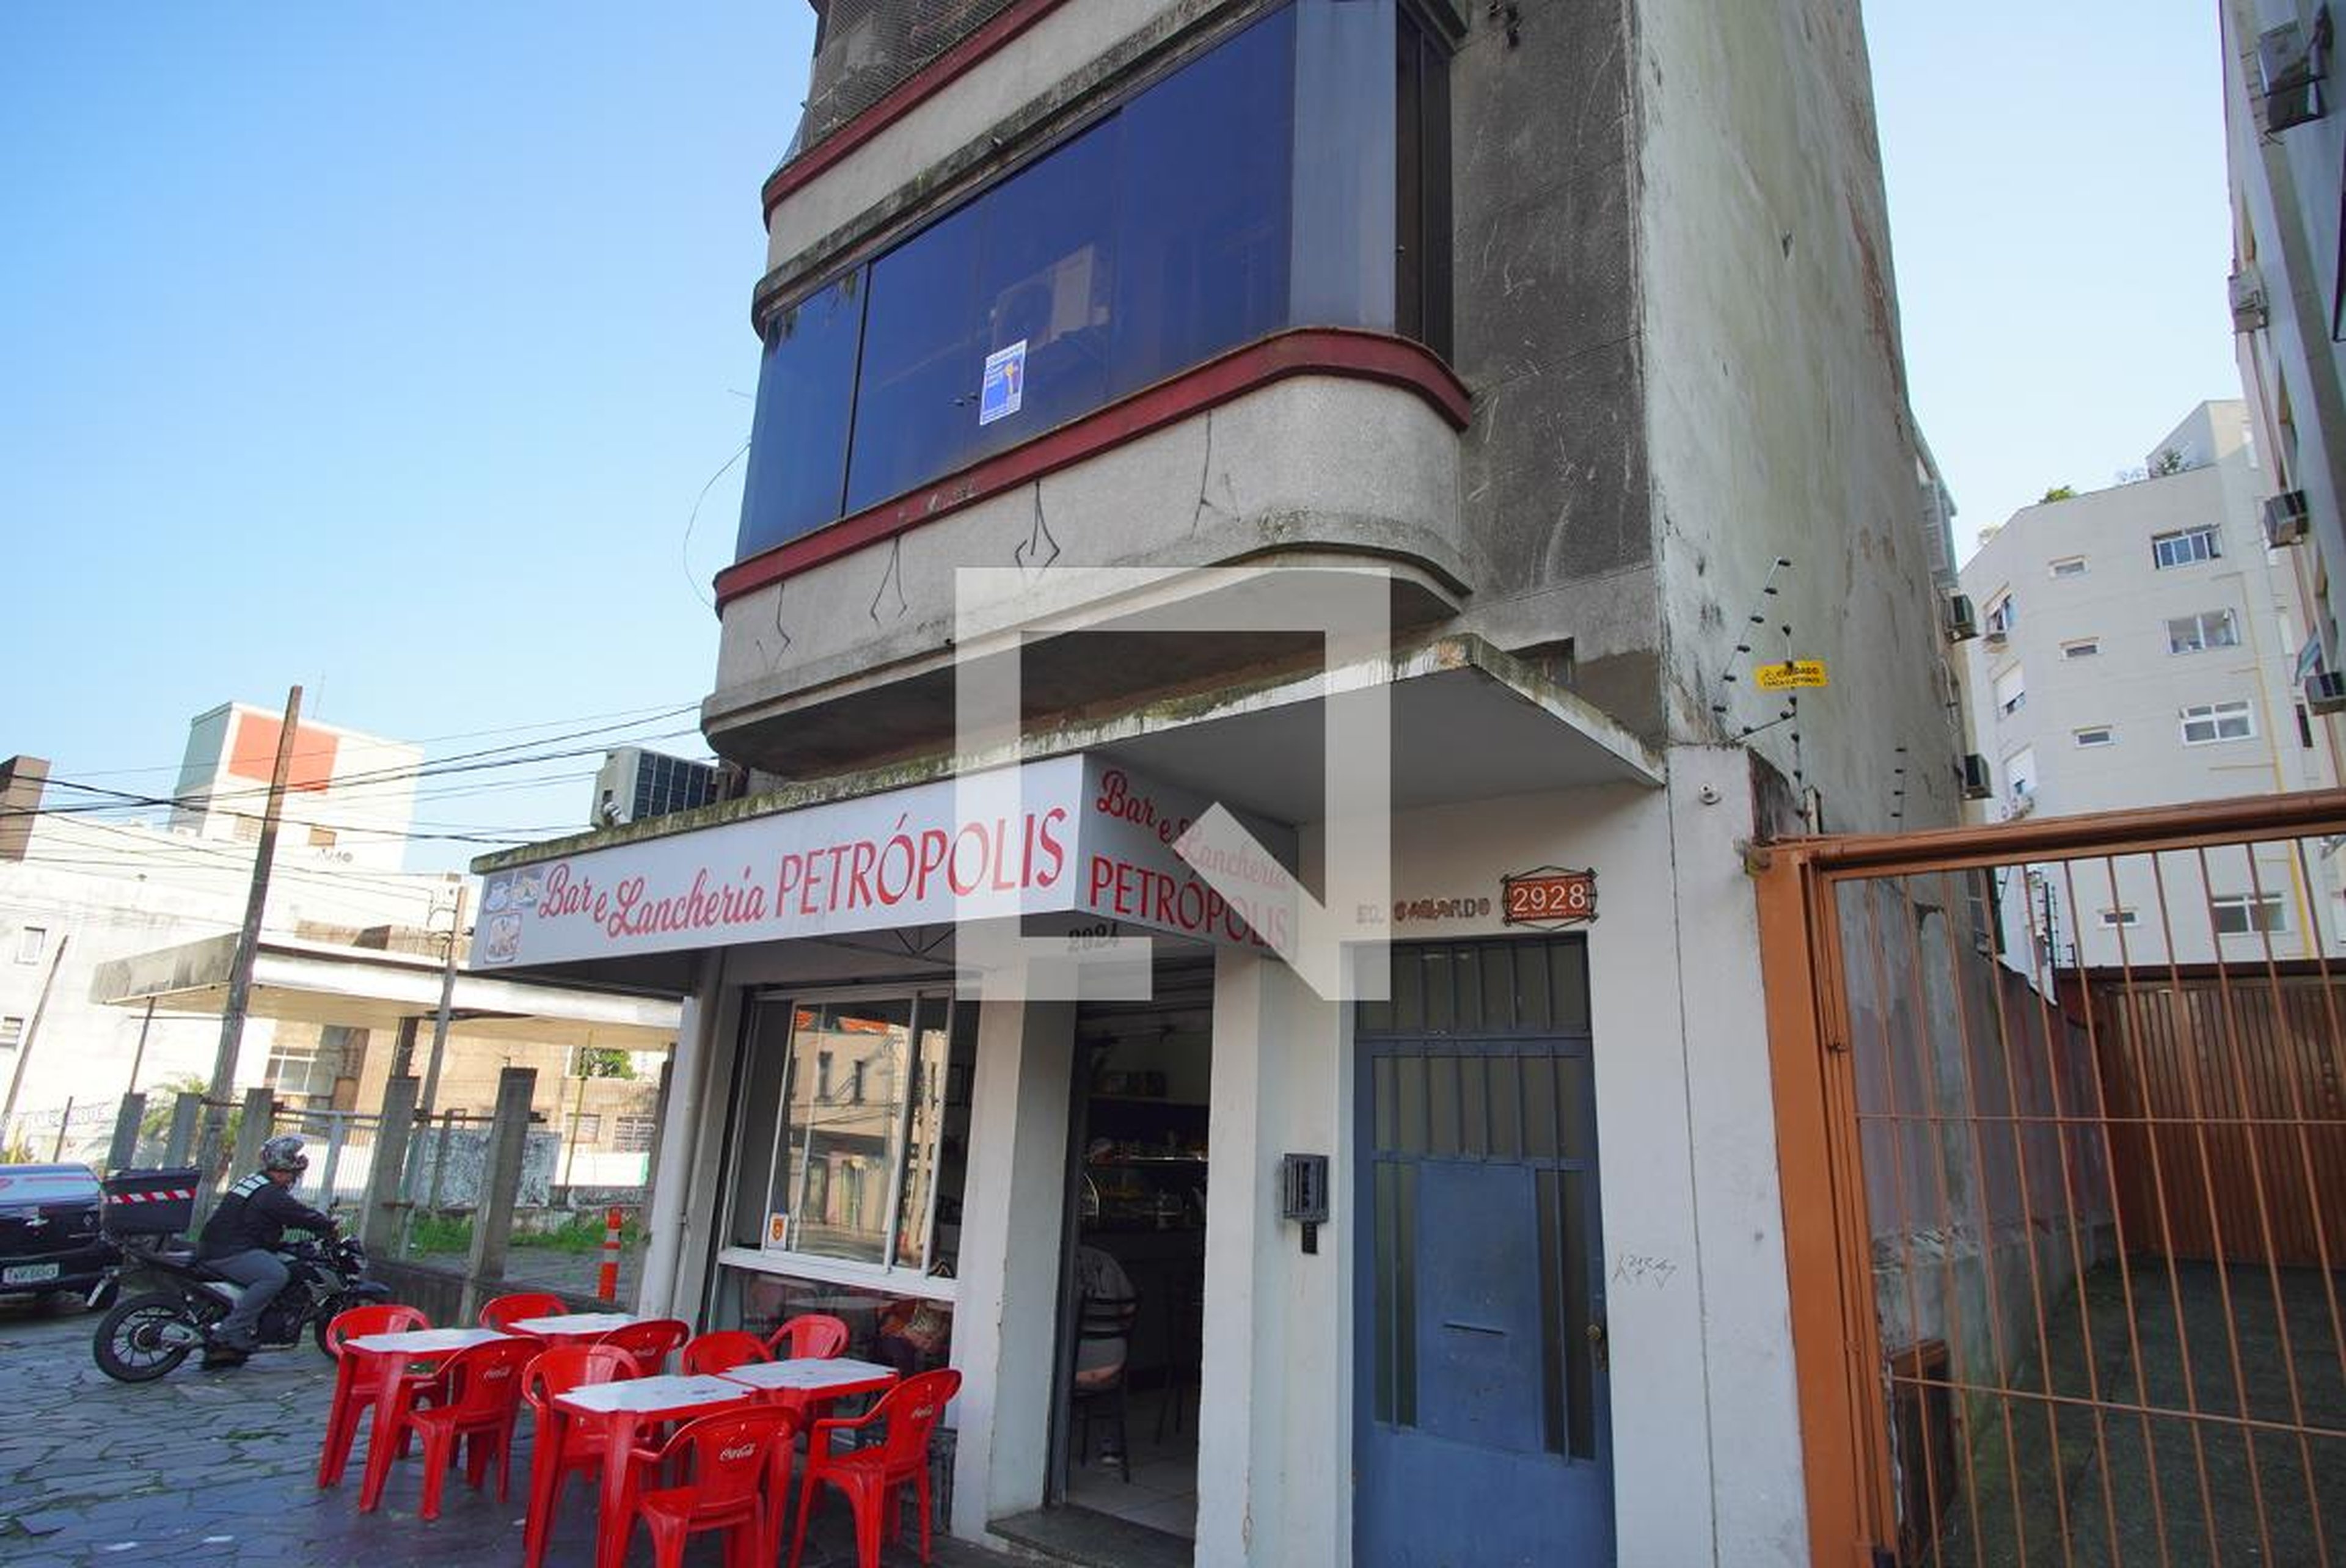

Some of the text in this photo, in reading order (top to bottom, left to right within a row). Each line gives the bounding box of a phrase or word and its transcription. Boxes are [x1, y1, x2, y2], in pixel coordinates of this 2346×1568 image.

[1097, 770, 1155, 826] Bar
[1159, 819, 1172, 845] e
[539, 806, 1067, 938] Bar e Lancheria PETRÓPOLIS
[1513, 883, 1585, 911] 2928
